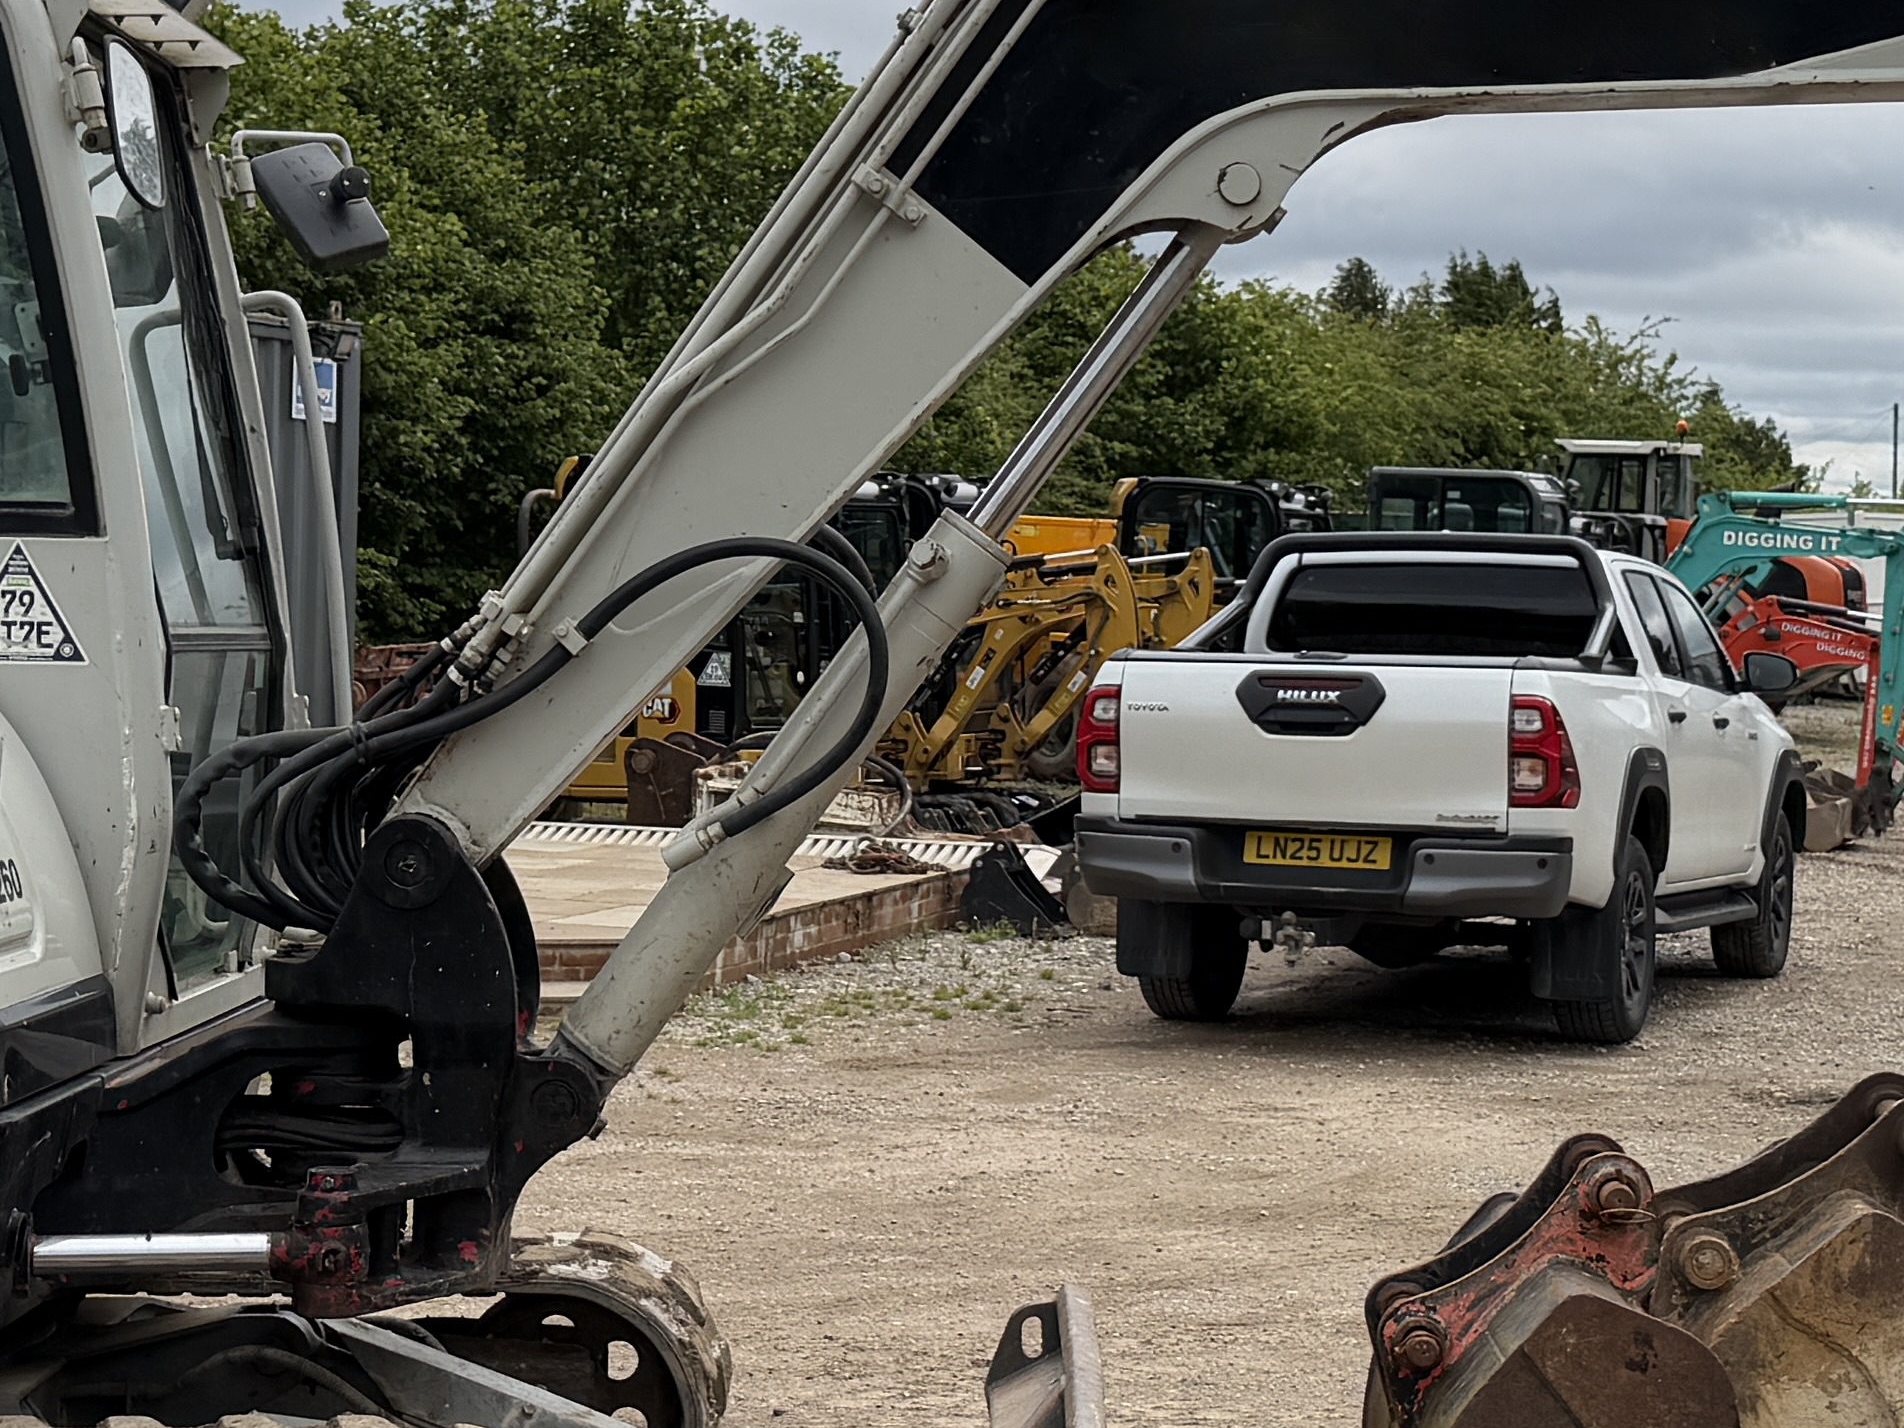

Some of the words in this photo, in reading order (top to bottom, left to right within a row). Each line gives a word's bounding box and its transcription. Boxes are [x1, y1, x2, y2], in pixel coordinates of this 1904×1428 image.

[1722, 530, 1814, 551] DIGGING
[1820, 535, 1842, 552] IT
[0, 589, 36, 618] 79
[1781, 622, 1830, 640] DIGGING
[1831, 632, 1843, 642] IT
[1816, 641, 1866, 661] DIGGING
[1276, 689, 1342, 703] HILUX
[642, 698, 672, 719] CAT
[1127, 702, 1170, 713] TOYOTA
[1255, 835, 1323, 861] LN25
[1328, 838, 1380, 864] UJZ
